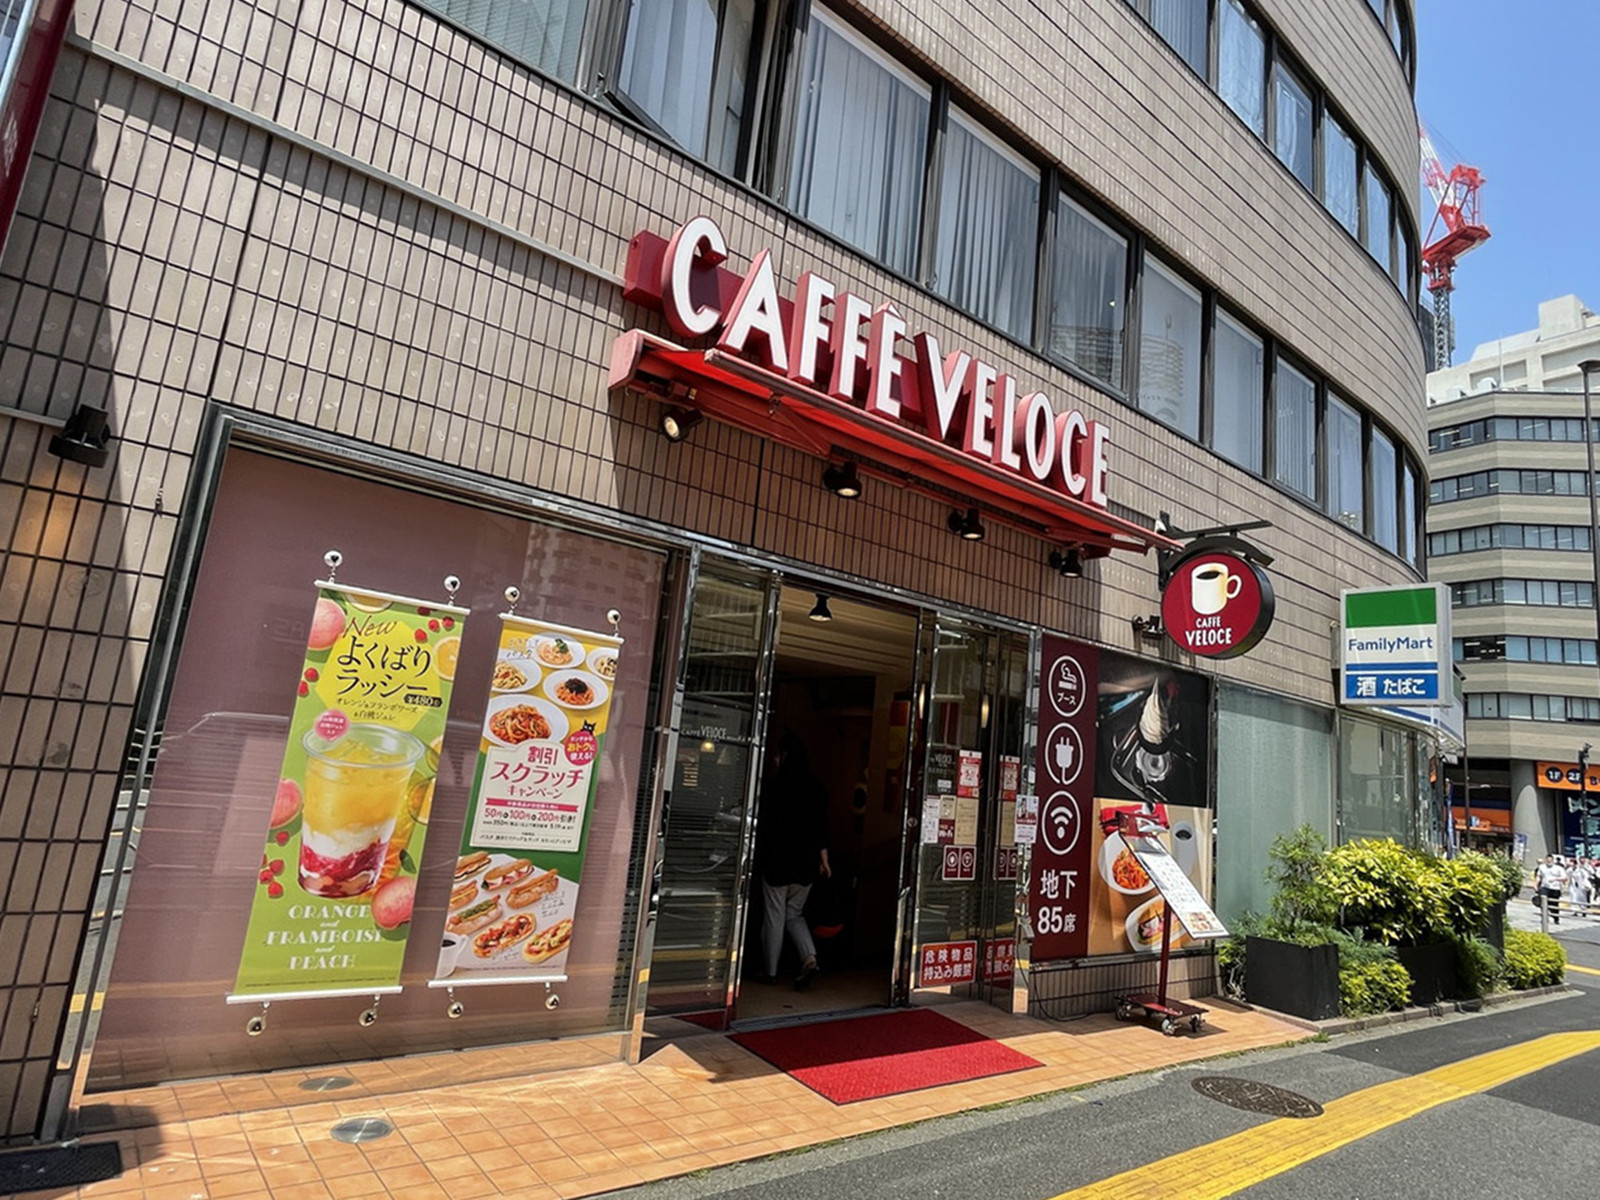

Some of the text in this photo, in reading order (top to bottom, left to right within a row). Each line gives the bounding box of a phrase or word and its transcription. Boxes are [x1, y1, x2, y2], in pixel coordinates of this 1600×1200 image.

[915, 331, 1111, 508] VELOCE
[342, 615, 397, 638] New
[1185, 628, 1232, 646] VELOCE
[1348, 636, 1433, 653] FamilyMart
[337, 635, 431, 677] よくばり
[336, 669, 428, 698] ラッシー
[1356, 676, 1426, 697] 酒 たばこ
[528, 746, 558, 765] 割引
[490, 761, 584, 788] スクラッチ
[508, 785, 563, 799] キャンペーン
[1040, 869, 1078, 899] 地下
[288, 904, 371, 919] ORANGE
[1037, 906, 1077, 934] 85席
[320, 920, 340, 928] and
[314, 945, 335, 953] and
[925, 947, 973, 964] 危険物品
[289, 955, 356, 970] PEACH
